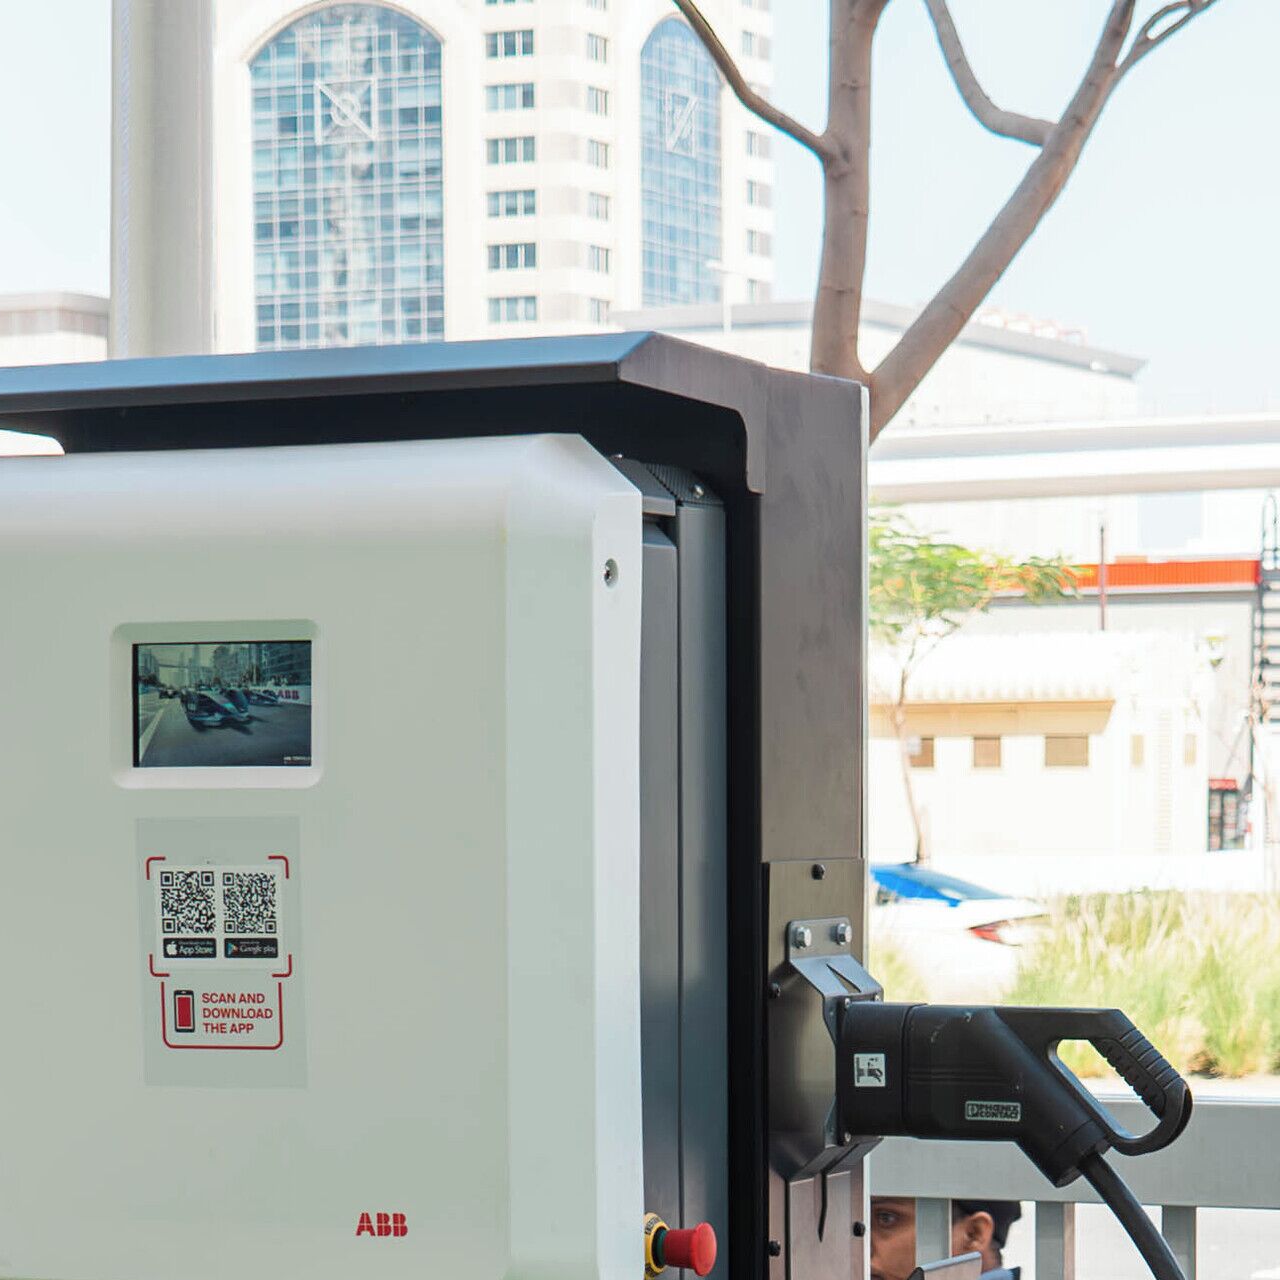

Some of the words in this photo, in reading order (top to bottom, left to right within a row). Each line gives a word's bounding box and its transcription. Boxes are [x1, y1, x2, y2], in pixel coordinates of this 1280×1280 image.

[202, 992, 236, 1004] SCAN
[238, 992, 265, 1004] AND
[202, 1008, 273, 1019] DOWNLOAD
[203, 1022, 227, 1034] THE
[230, 1023, 254, 1034] APP
[356, 1212, 408, 1237] ABB
